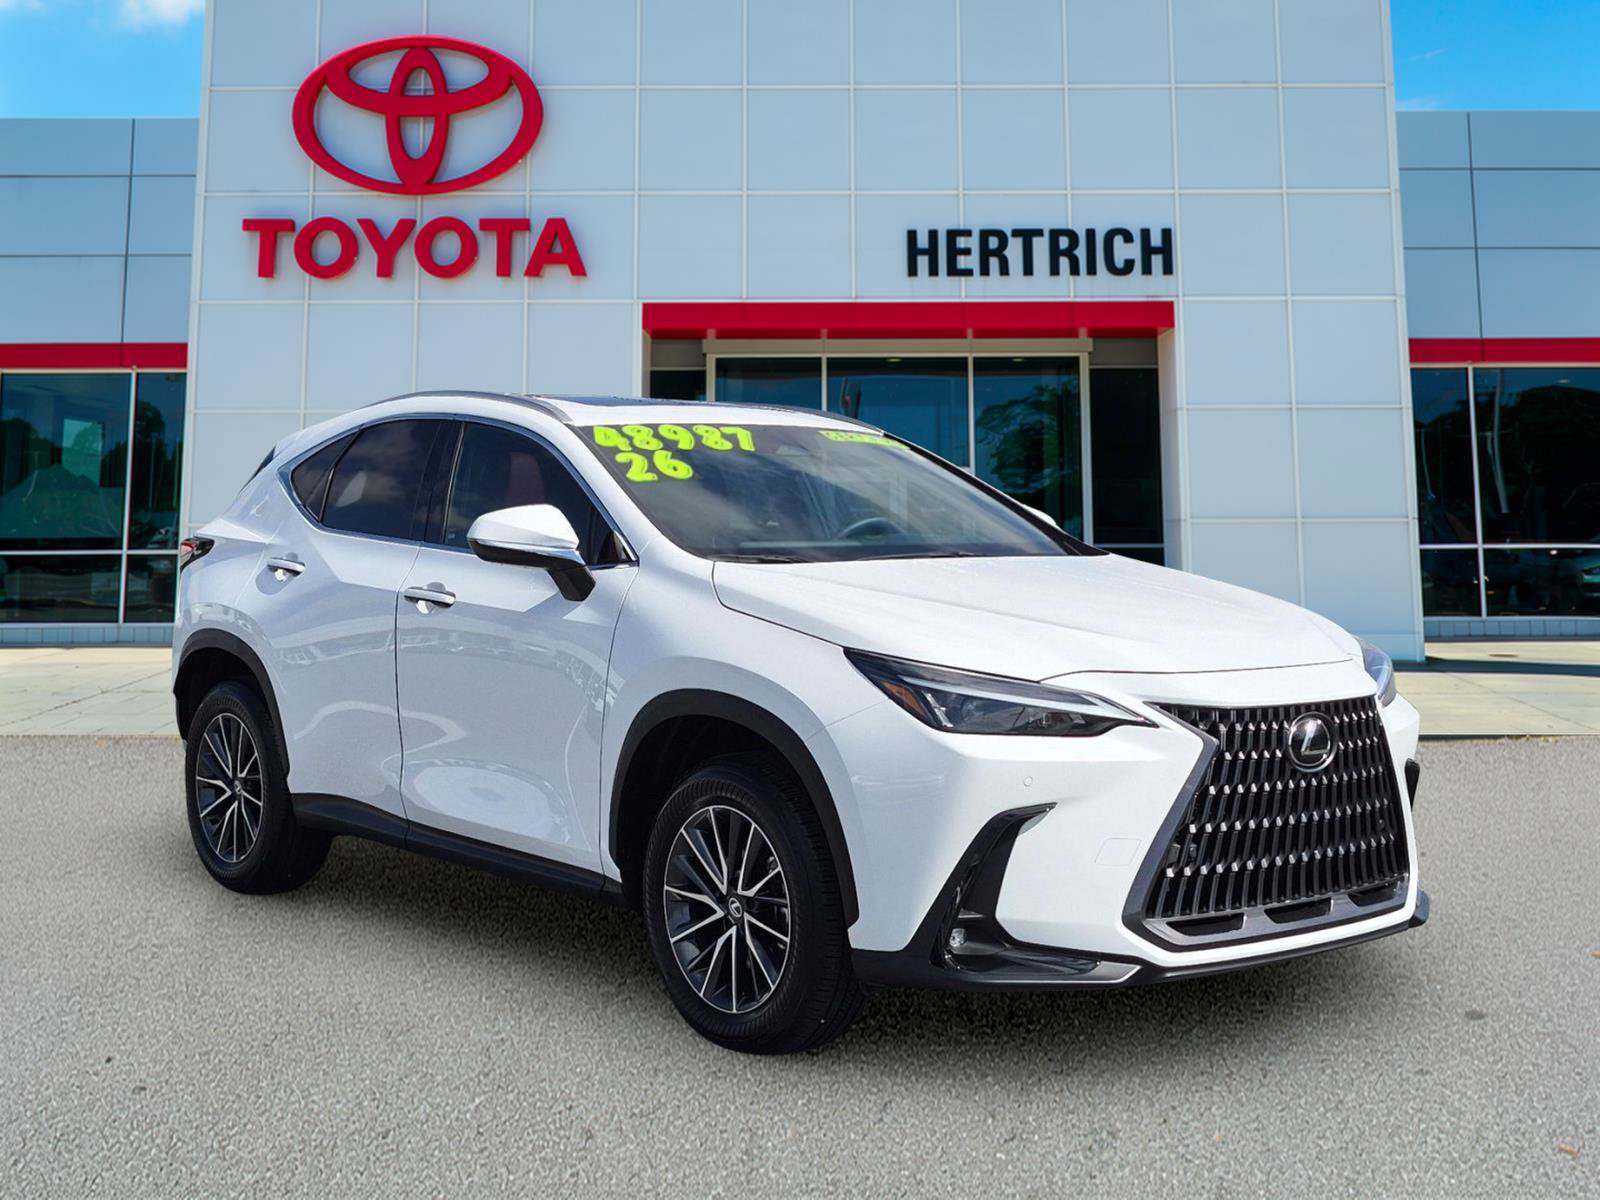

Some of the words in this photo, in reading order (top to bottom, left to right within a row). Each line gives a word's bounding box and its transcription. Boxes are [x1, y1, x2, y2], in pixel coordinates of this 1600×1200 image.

[242, 216, 588, 279] TOYOTA
[906, 227, 1174, 277] HERTRICH
[615, 450, 694, 483] 26
